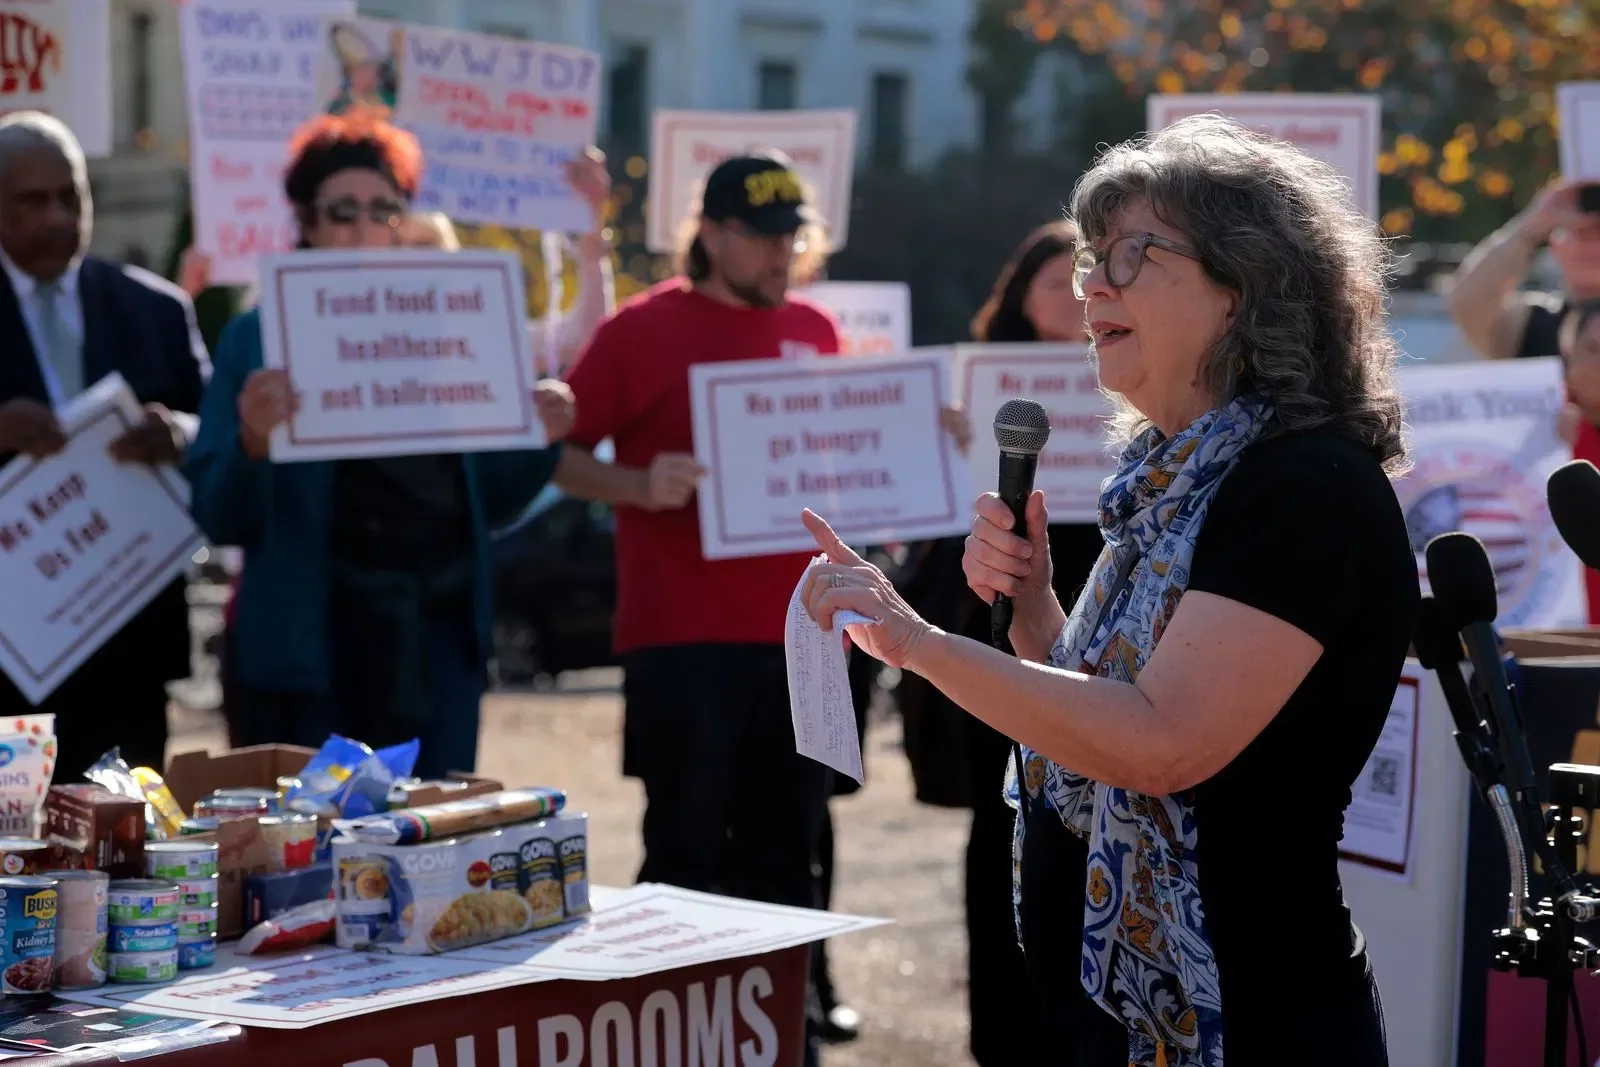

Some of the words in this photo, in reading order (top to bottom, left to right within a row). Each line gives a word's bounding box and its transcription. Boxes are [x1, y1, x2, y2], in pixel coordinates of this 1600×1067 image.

[316, 287, 377, 317] Fund
[384, 286, 437, 315] food
[445, 282, 485, 314] and
[336, 330, 477, 361] healthcare,
[320, 381, 364, 411] not
[370, 377, 497, 409] ballrooms.
[745, 391, 775, 416] No
[779, 392, 823, 414] one
[830, 382, 906, 411] should
[767, 435, 796, 463] go
[801, 428, 884, 457] hungry
[765, 474, 791, 497] in
[795, 468, 896, 494] America.
[64, 507, 112, 554] Fed
[402, 850, 458, 875] GOYA
[16, 934, 48, 949] Kidney
[343, 965, 780, 1067] ROOMS
